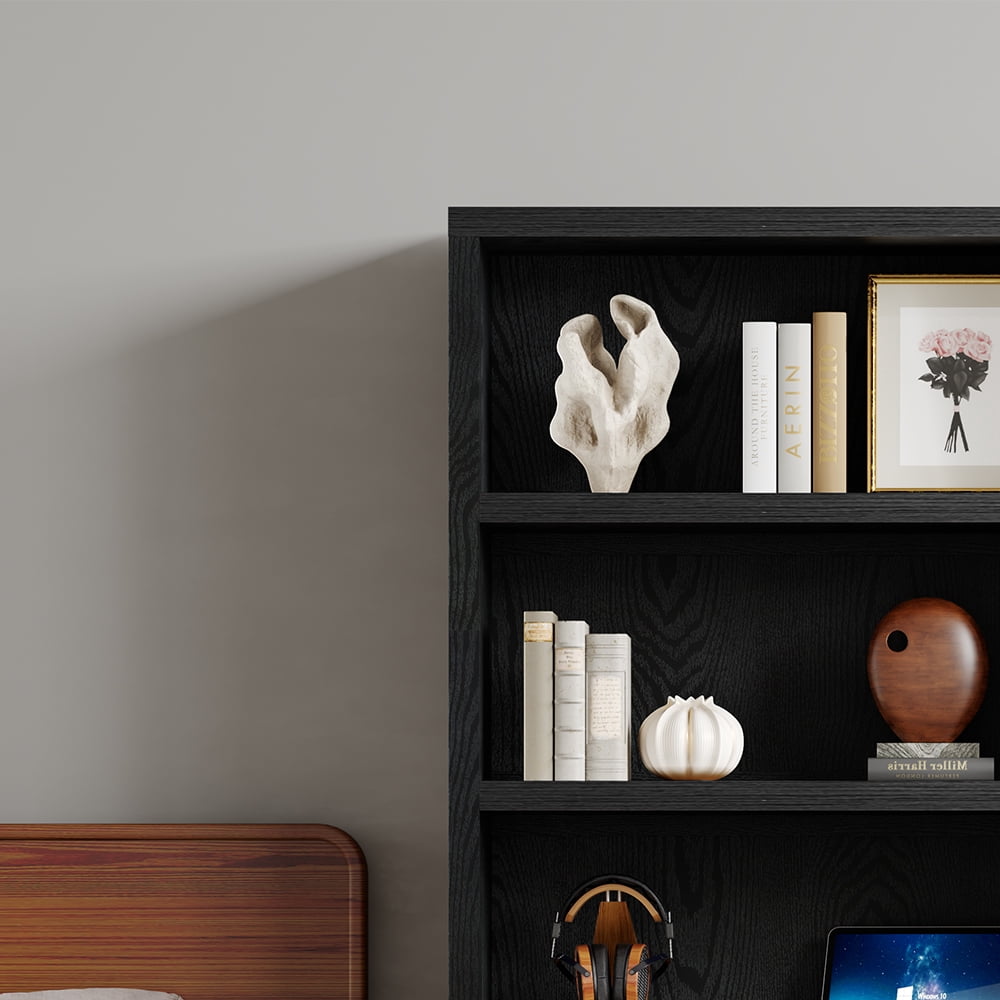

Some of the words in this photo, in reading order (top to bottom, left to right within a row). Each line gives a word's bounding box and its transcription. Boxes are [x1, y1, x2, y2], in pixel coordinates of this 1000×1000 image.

[751, 391, 759, 413] THE
[784, 365, 802, 459] AERIN
[751, 418, 759, 466] AROUND
